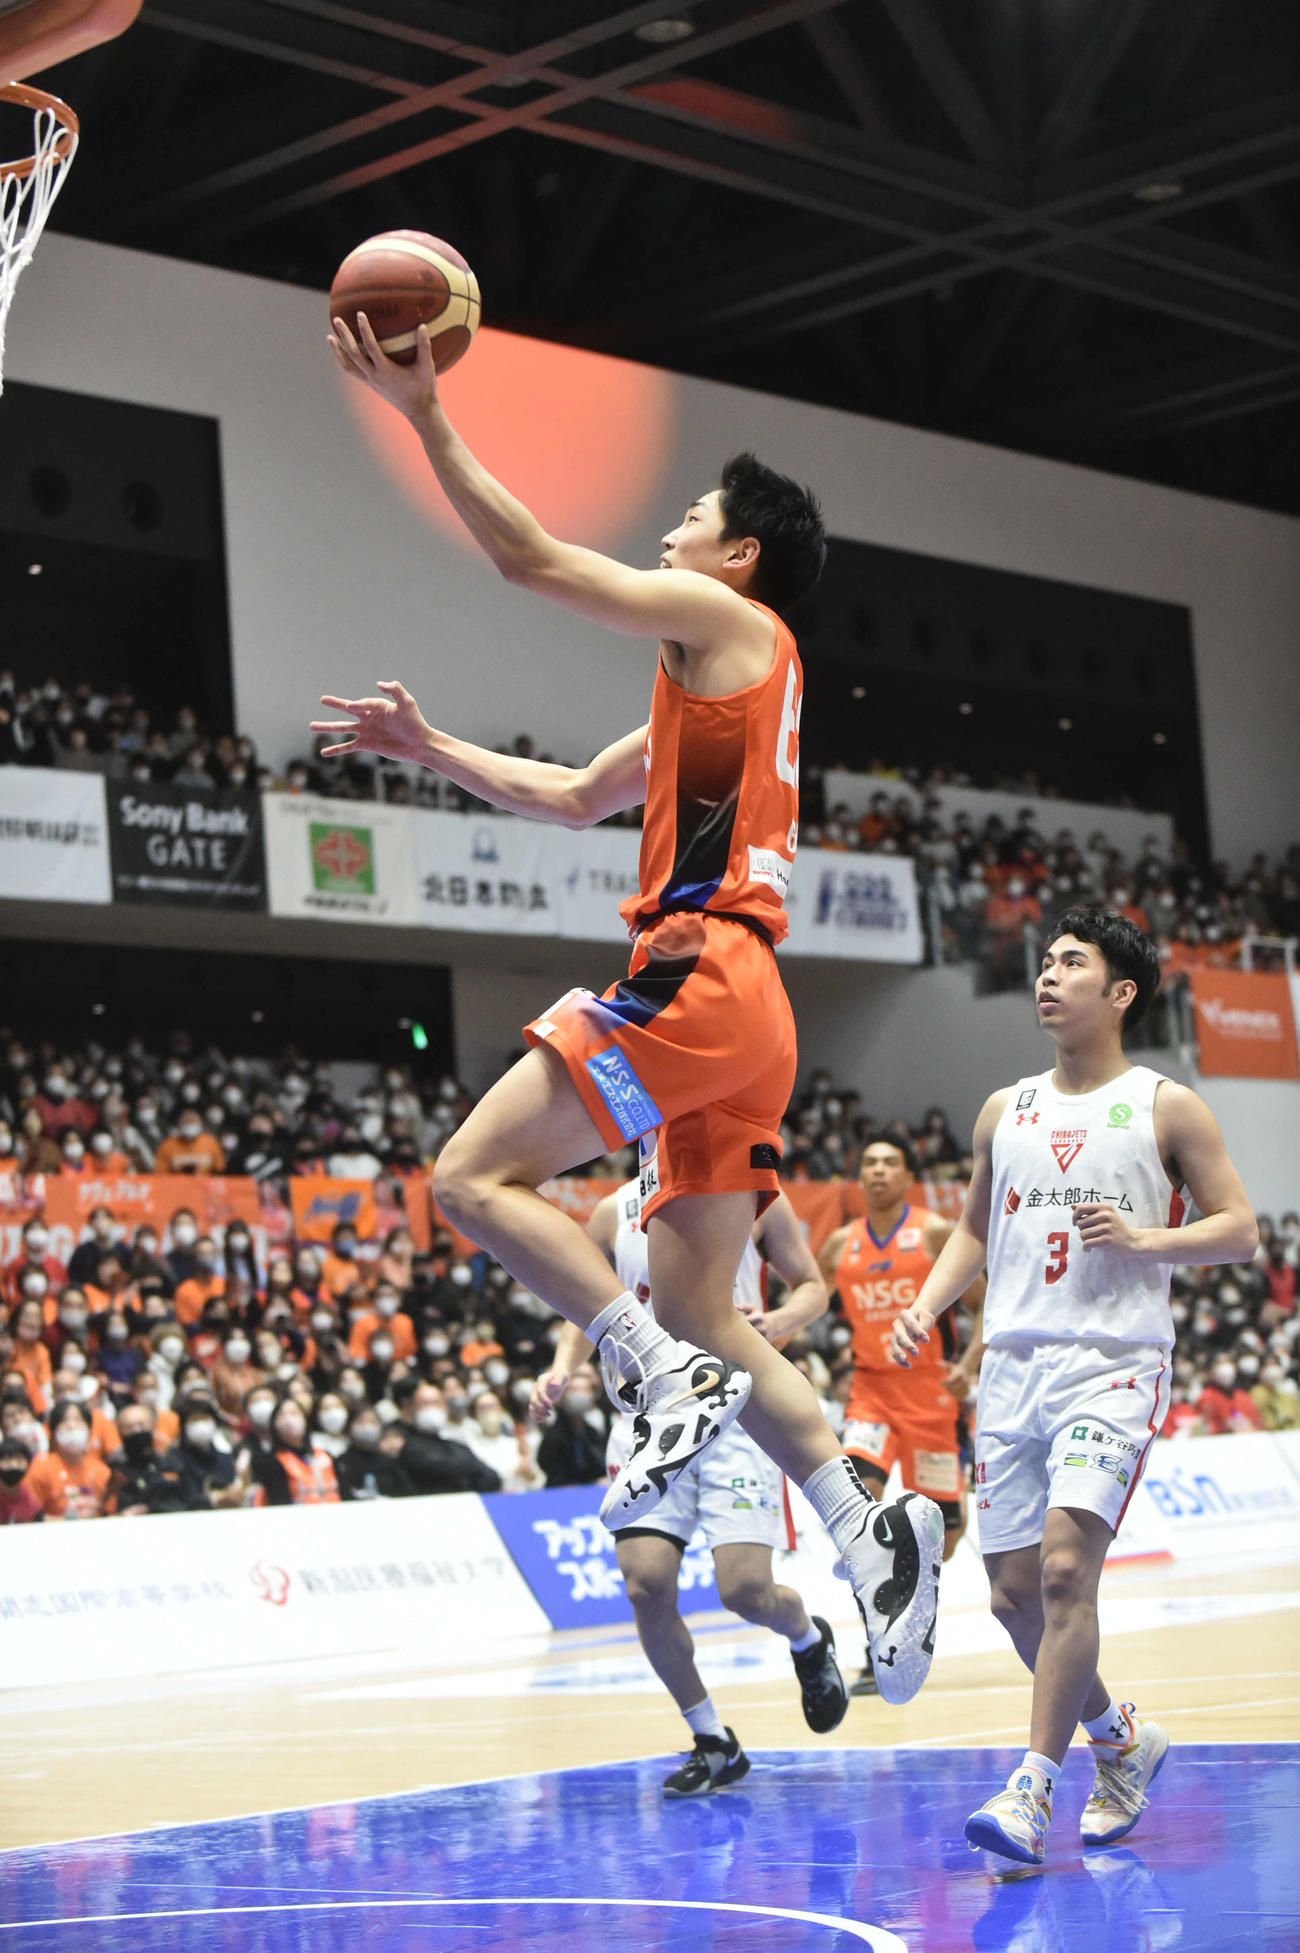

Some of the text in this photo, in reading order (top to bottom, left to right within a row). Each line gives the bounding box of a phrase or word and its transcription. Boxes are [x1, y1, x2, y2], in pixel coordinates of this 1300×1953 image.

[120, 796, 183, 835] Sony
[186, 802, 248, 834] Bank
[146, 834, 225, 871] GATE
[1025, 1187, 1134, 1213] 金太郎ホーム
[1045, 1232, 1070, 1285] 3
[850, 1278, 916, 1311] NSG
